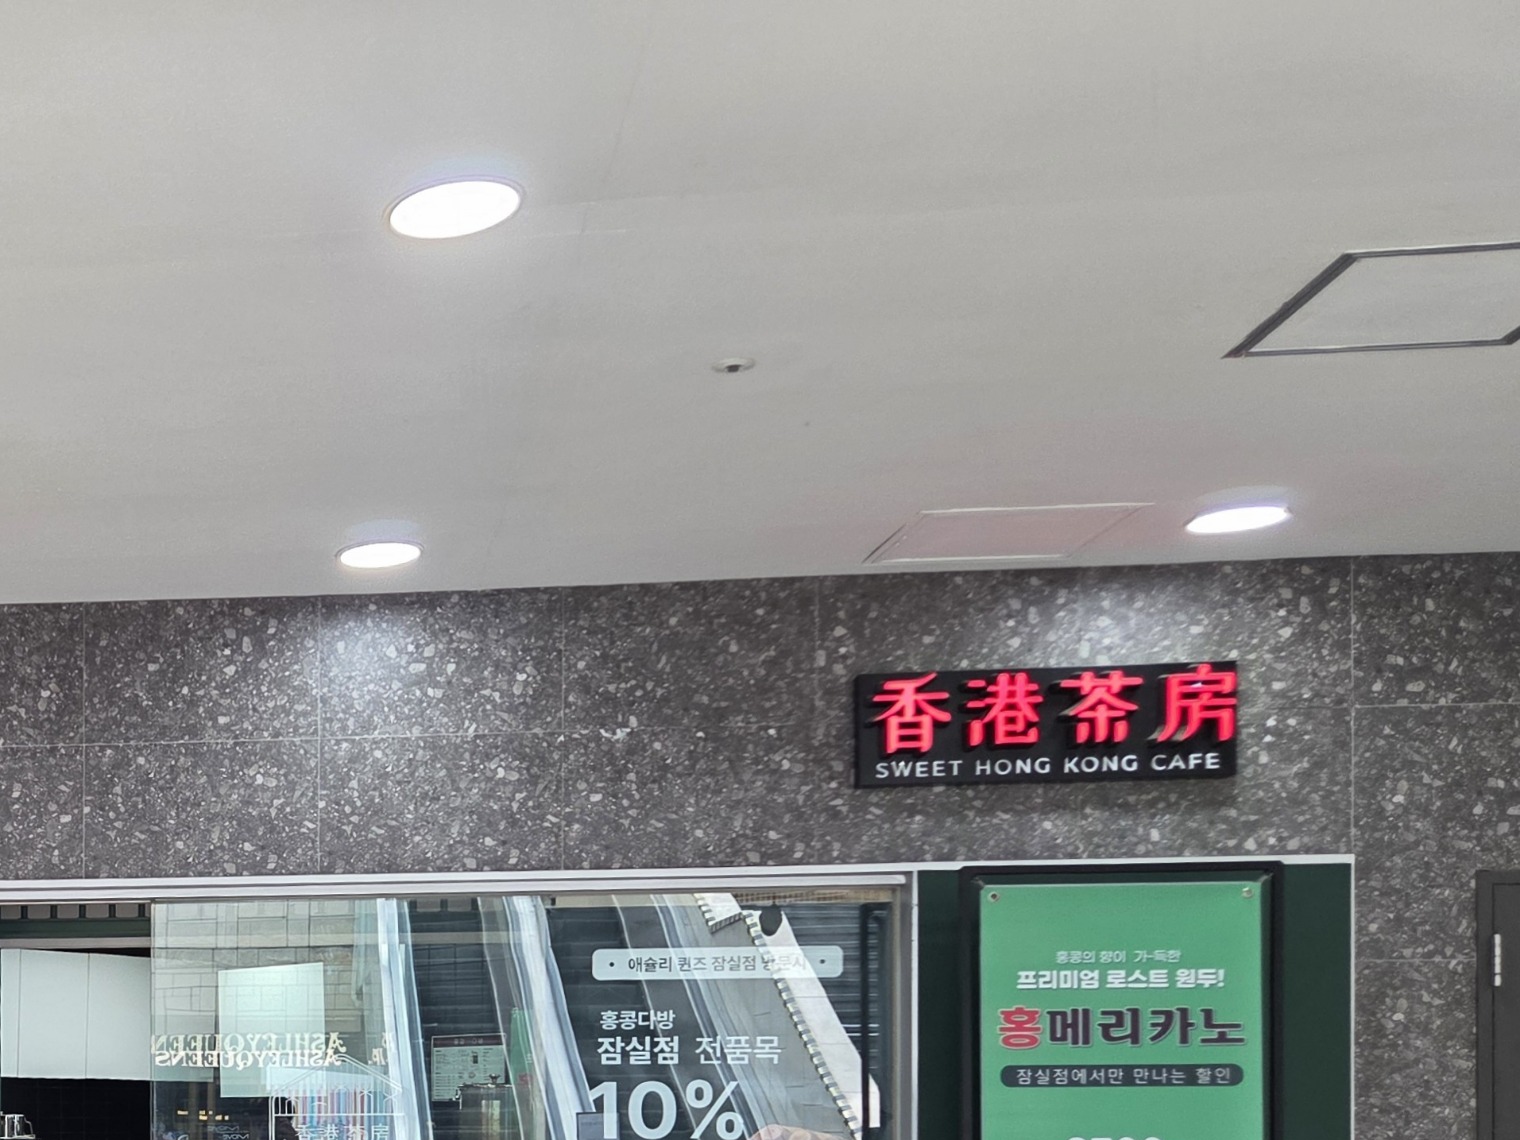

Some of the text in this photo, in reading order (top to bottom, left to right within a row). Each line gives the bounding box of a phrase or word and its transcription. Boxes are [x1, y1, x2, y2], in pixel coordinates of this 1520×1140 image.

[872, 664, 1238, 754] 香港茶房
[875, 752, 1221, 779] SWEET HONG KONG CAFE
[628, 956, 672, 973] 애슐리
[678, 956, 707, 973] 퀸즈
[711, 955, 757, 972] 잠실점
[1056, 950, 1096, 965] 홍콩의
[1099, 950, 1126, 964] 향이
[1016, 967, 1226, 990] 프리미엄 로스트 원두!
[600, 1009, 676, 1030] 홍콩다방
[997, 1004, 1247, 1050] 홍메리카노
[597, 1035, 782, 1065] 잠실점 전품목
[1016, 1066, 1232, 1086] 잠실점에서만 만나는 할인
[589, 1079, 745, 1140] 10%
